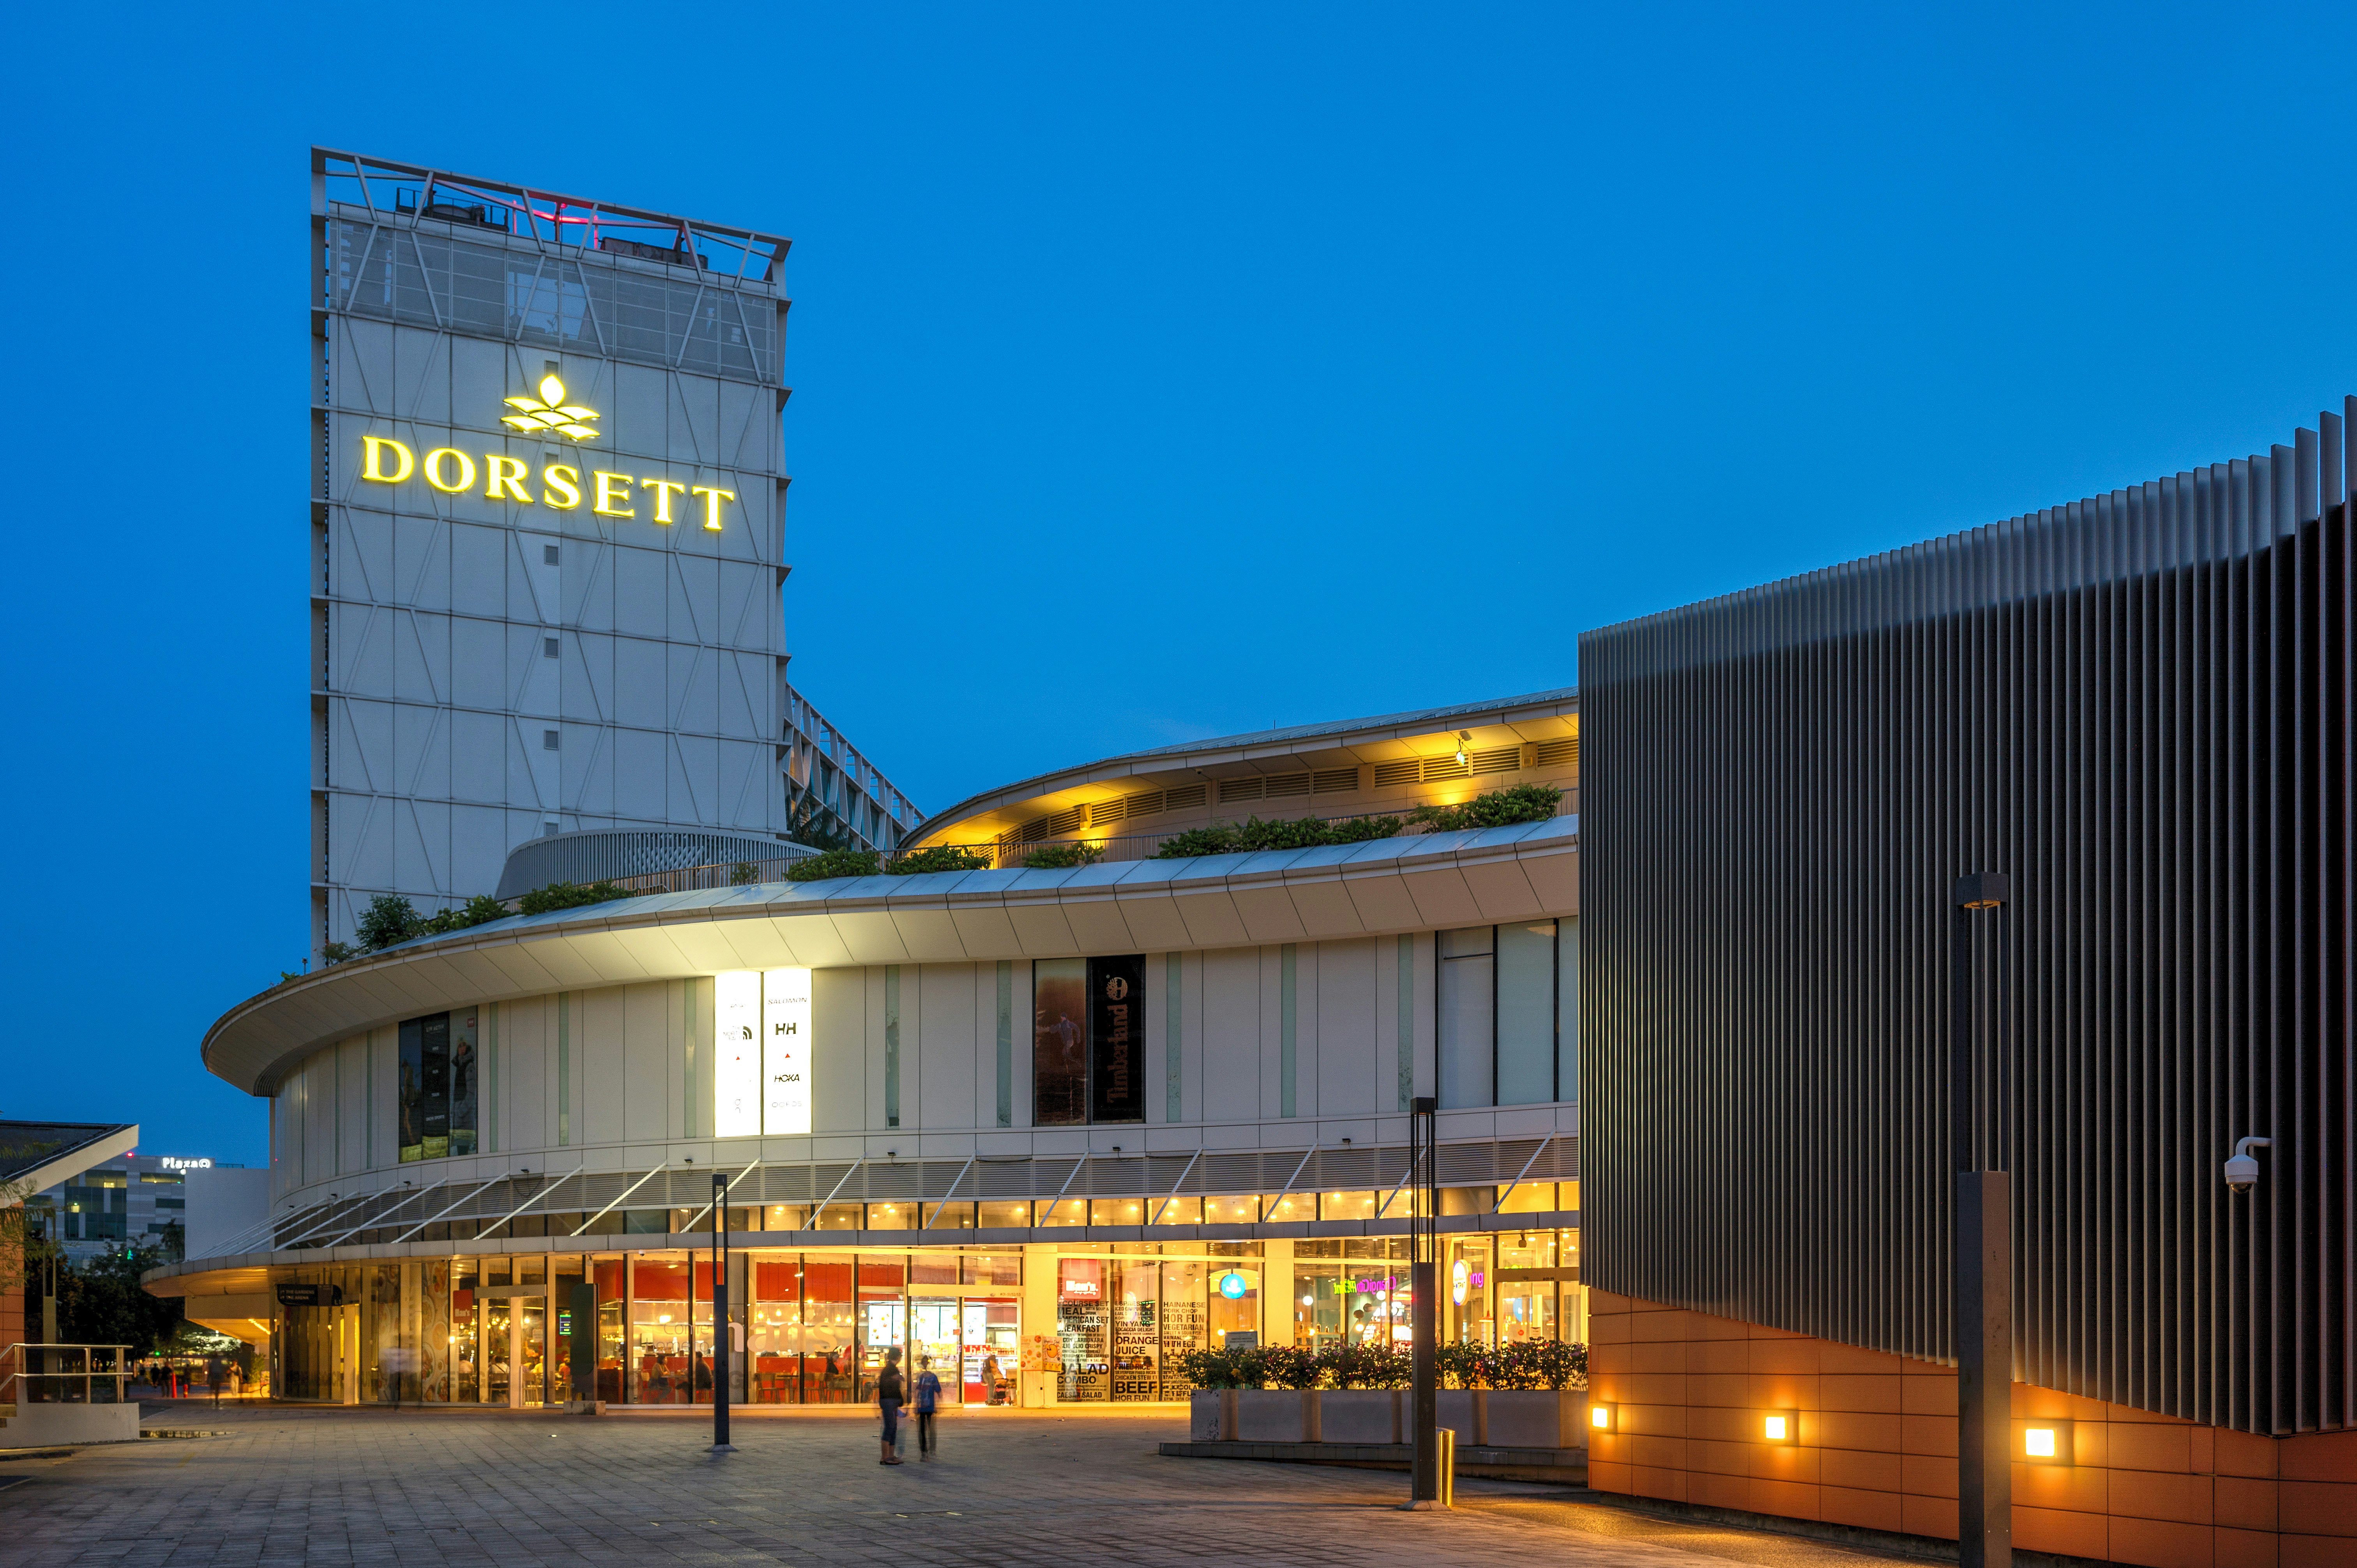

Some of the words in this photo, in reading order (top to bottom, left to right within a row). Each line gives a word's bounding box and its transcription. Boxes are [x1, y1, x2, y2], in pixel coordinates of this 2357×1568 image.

[362, 436, 734, 530] DORSETT
[775, 1022, 797, 1035] HH
[1107, 1004, 1128, 1103] Timberland
[774, 1074, 800, 1082] HOKA
[1163, 1314, 1182, 1323] HOR
[1186, 1314, 1204, 1323] FUN
[664, 1323, 709, 1335] Come
[1115, 1346, 1146, 1354] JUICE
[1057, 1363, 1110, 1375] SALAD
[1057, 1376, 1096, 1384] COMBO
[1115, 1381, 1157, 1393] BEEF
